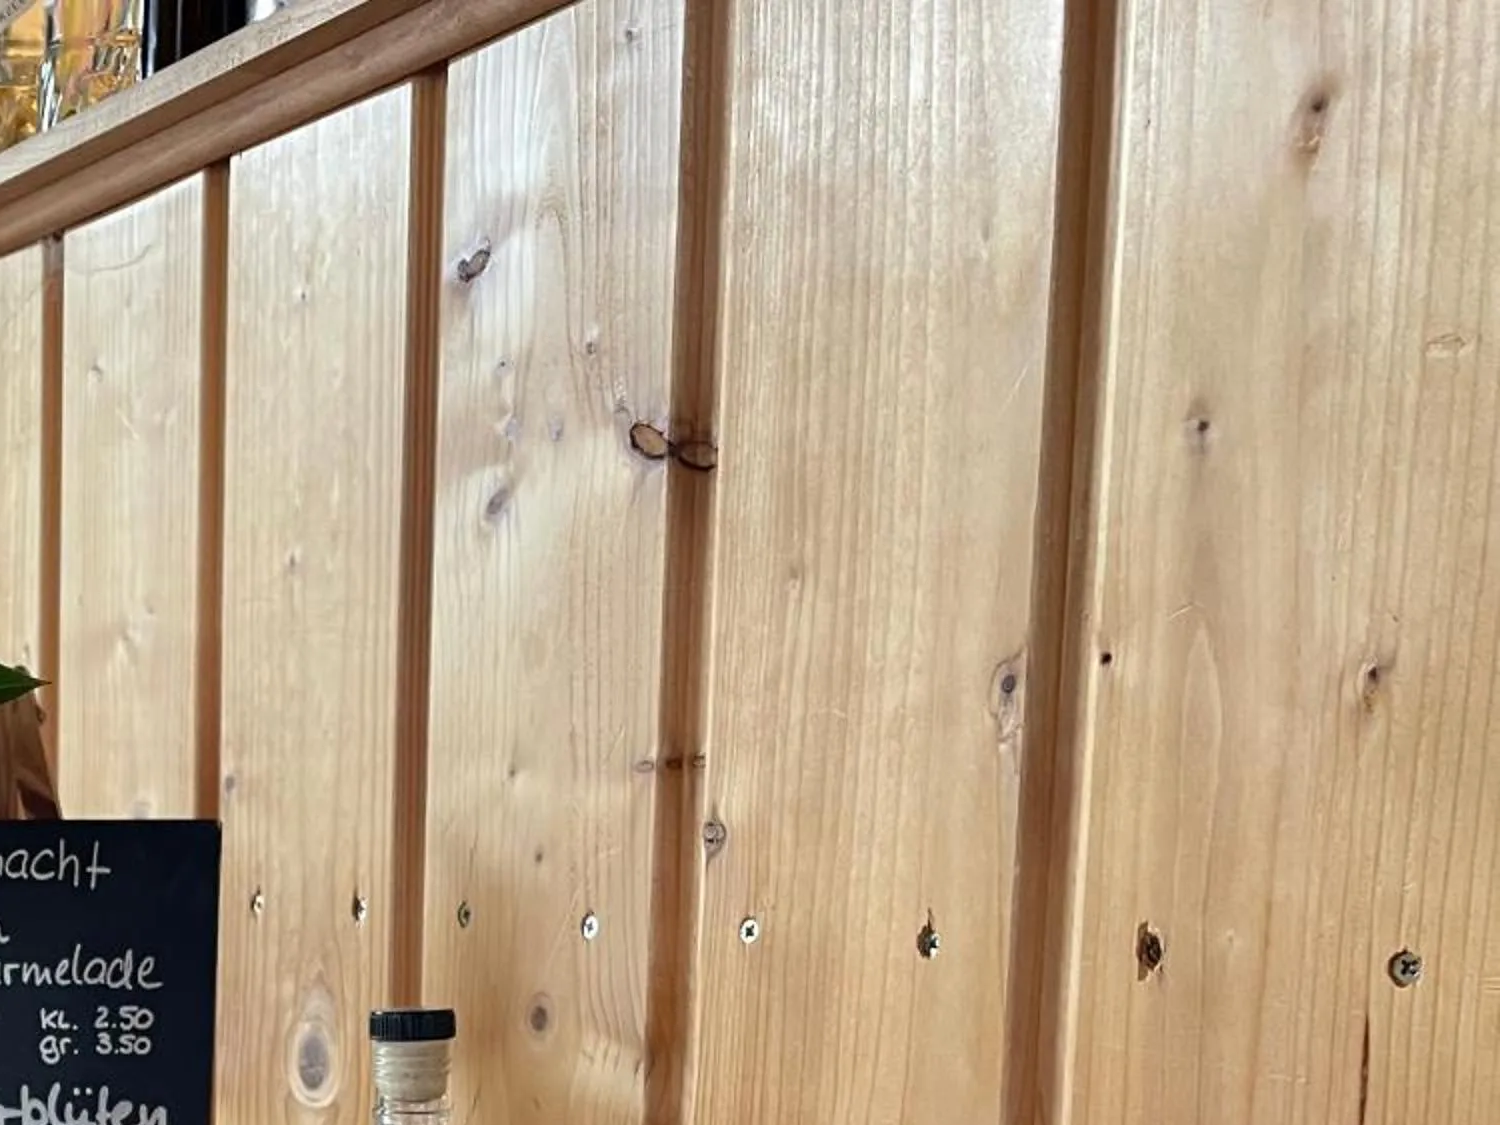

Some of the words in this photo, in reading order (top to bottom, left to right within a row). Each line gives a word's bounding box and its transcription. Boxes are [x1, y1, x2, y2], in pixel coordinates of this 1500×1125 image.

[94, 1005, 154, 1031] 2.50
[39, 1034, 79, 1065] gr.
[95, 1031, 152, 1055] 3.50
